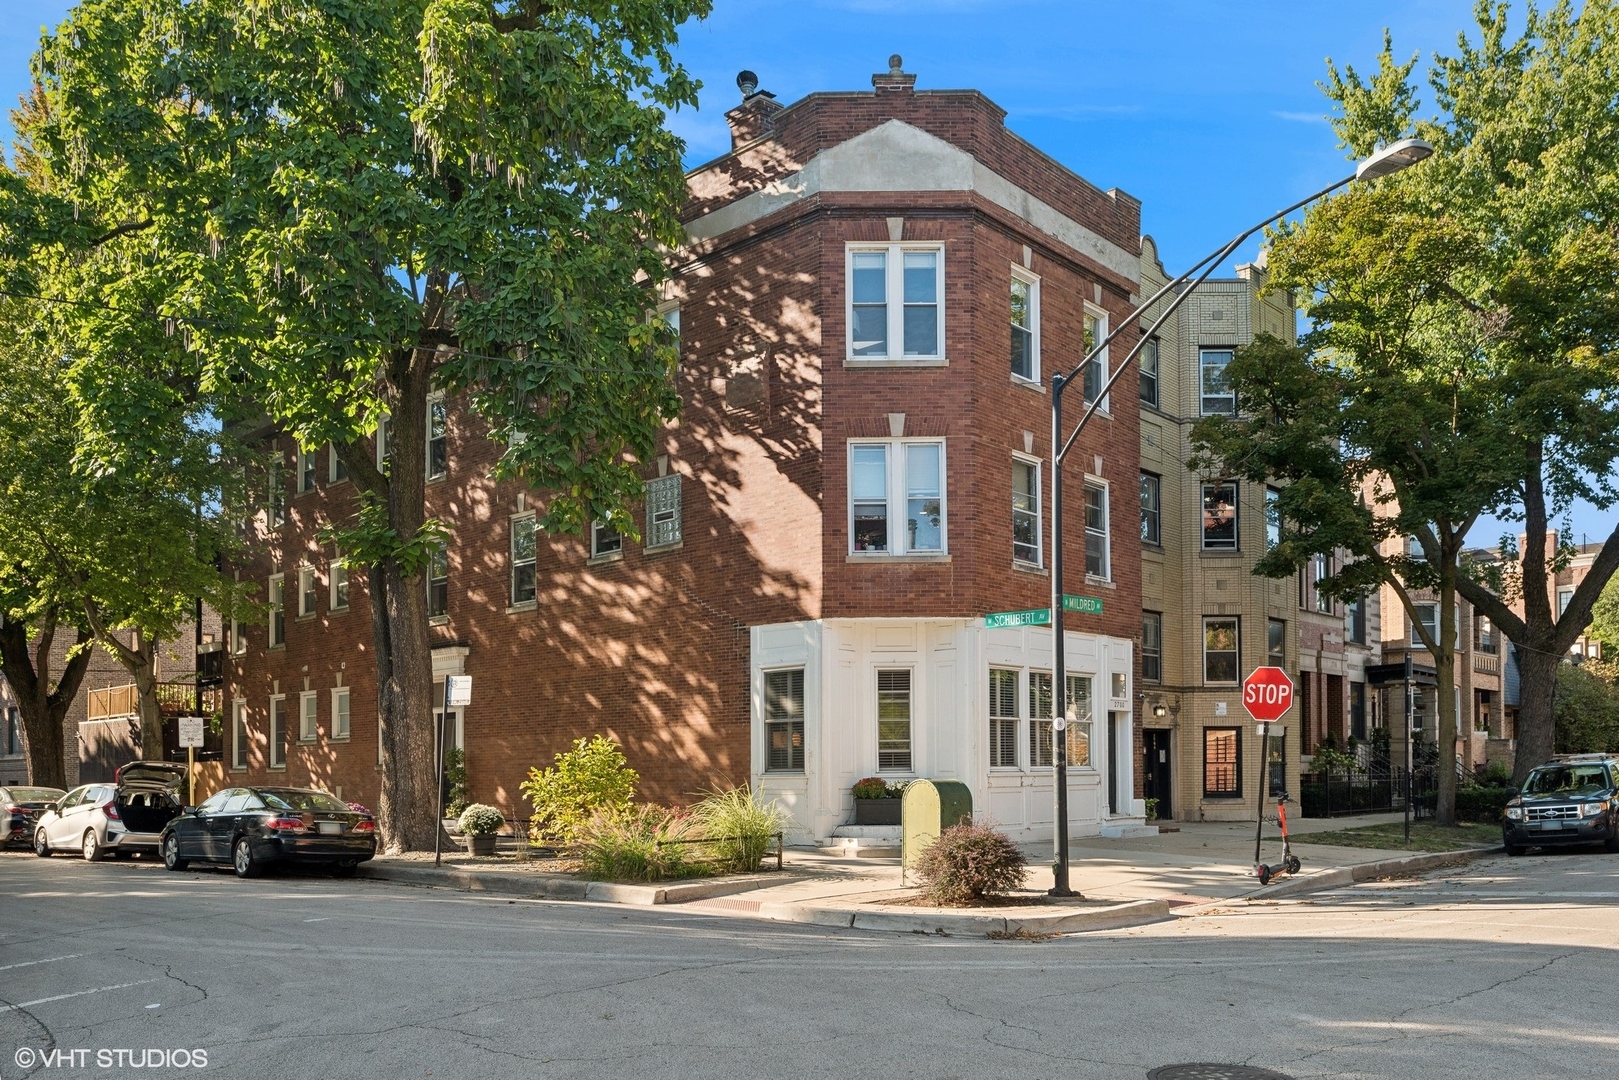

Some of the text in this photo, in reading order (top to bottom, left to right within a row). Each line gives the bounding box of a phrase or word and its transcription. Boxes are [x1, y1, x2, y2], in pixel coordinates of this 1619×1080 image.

[1069, 598, 1095, 611] MILDRED
[994, 612, 1036, 627] SCHUBERT
[1246, 684, 1289, 704] STOP
